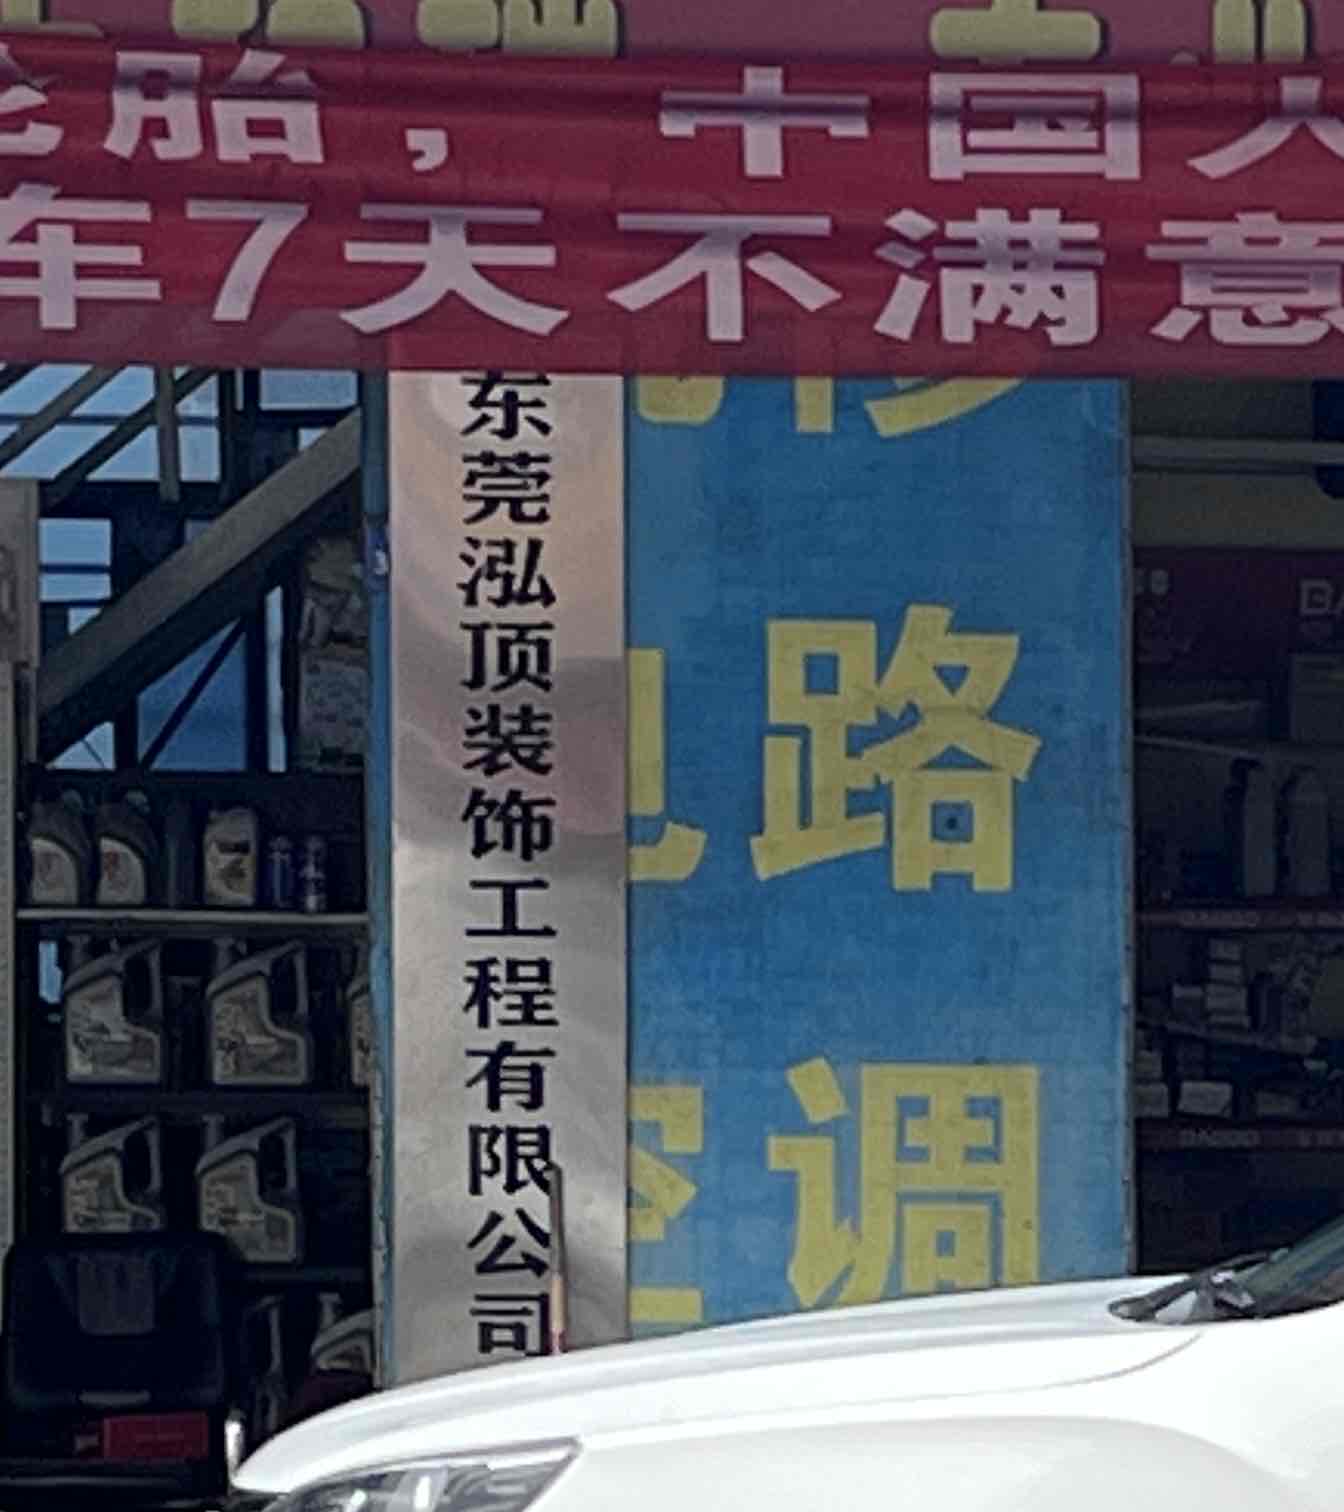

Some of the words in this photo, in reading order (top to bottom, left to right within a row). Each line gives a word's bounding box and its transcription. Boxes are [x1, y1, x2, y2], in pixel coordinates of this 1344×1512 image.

[457, 371, 559, 1357] 东莞泓顶装饰工程有限公司
